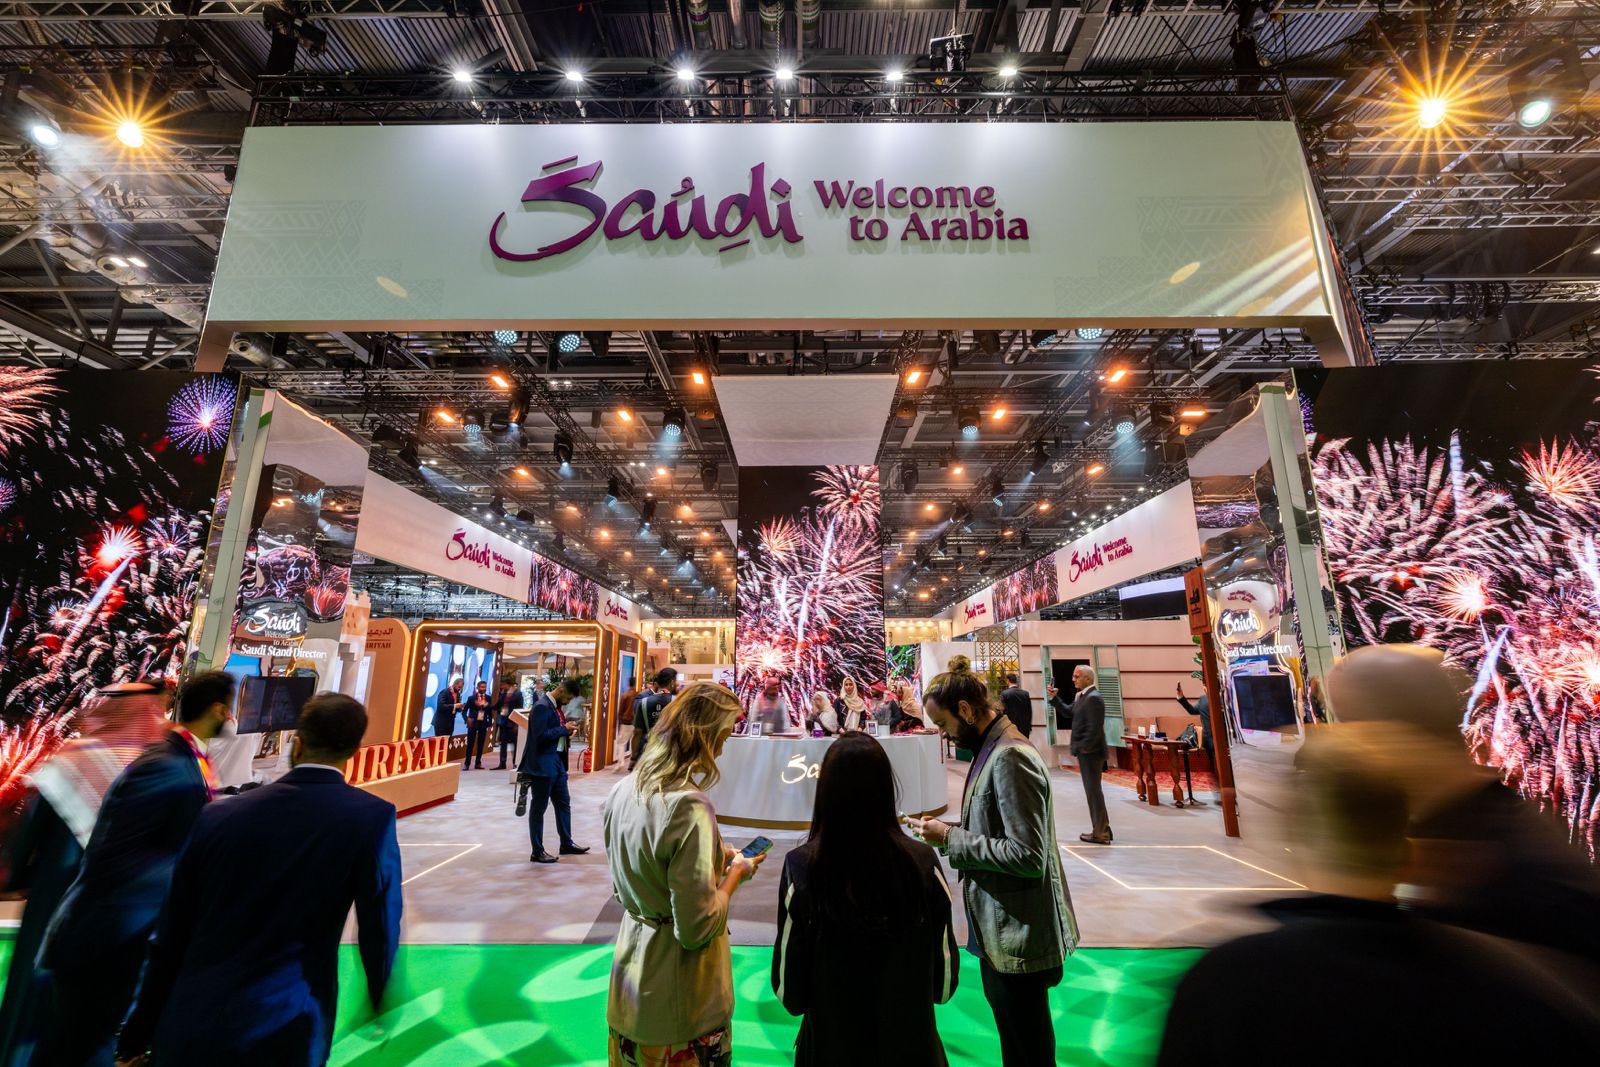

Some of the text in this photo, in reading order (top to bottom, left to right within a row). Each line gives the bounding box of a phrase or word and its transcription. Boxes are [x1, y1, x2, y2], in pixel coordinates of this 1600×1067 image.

[489, 155, 804, 262] Saudi
[814, 178, 996, 209] Welcome
[849, 208, 1029, 241] to Arabia
[446, 528, 490, 569] Saudi
[1069, 543, 1104, 582] Saudi
[245, 605, 301, 634] Saudi
[1221, 609, 1260, 638] Saudi
[240, 644, 267, 655] Saudi
[267, 645, 292, 657] Stand
[1240, 645, 1259, 656] Stand
